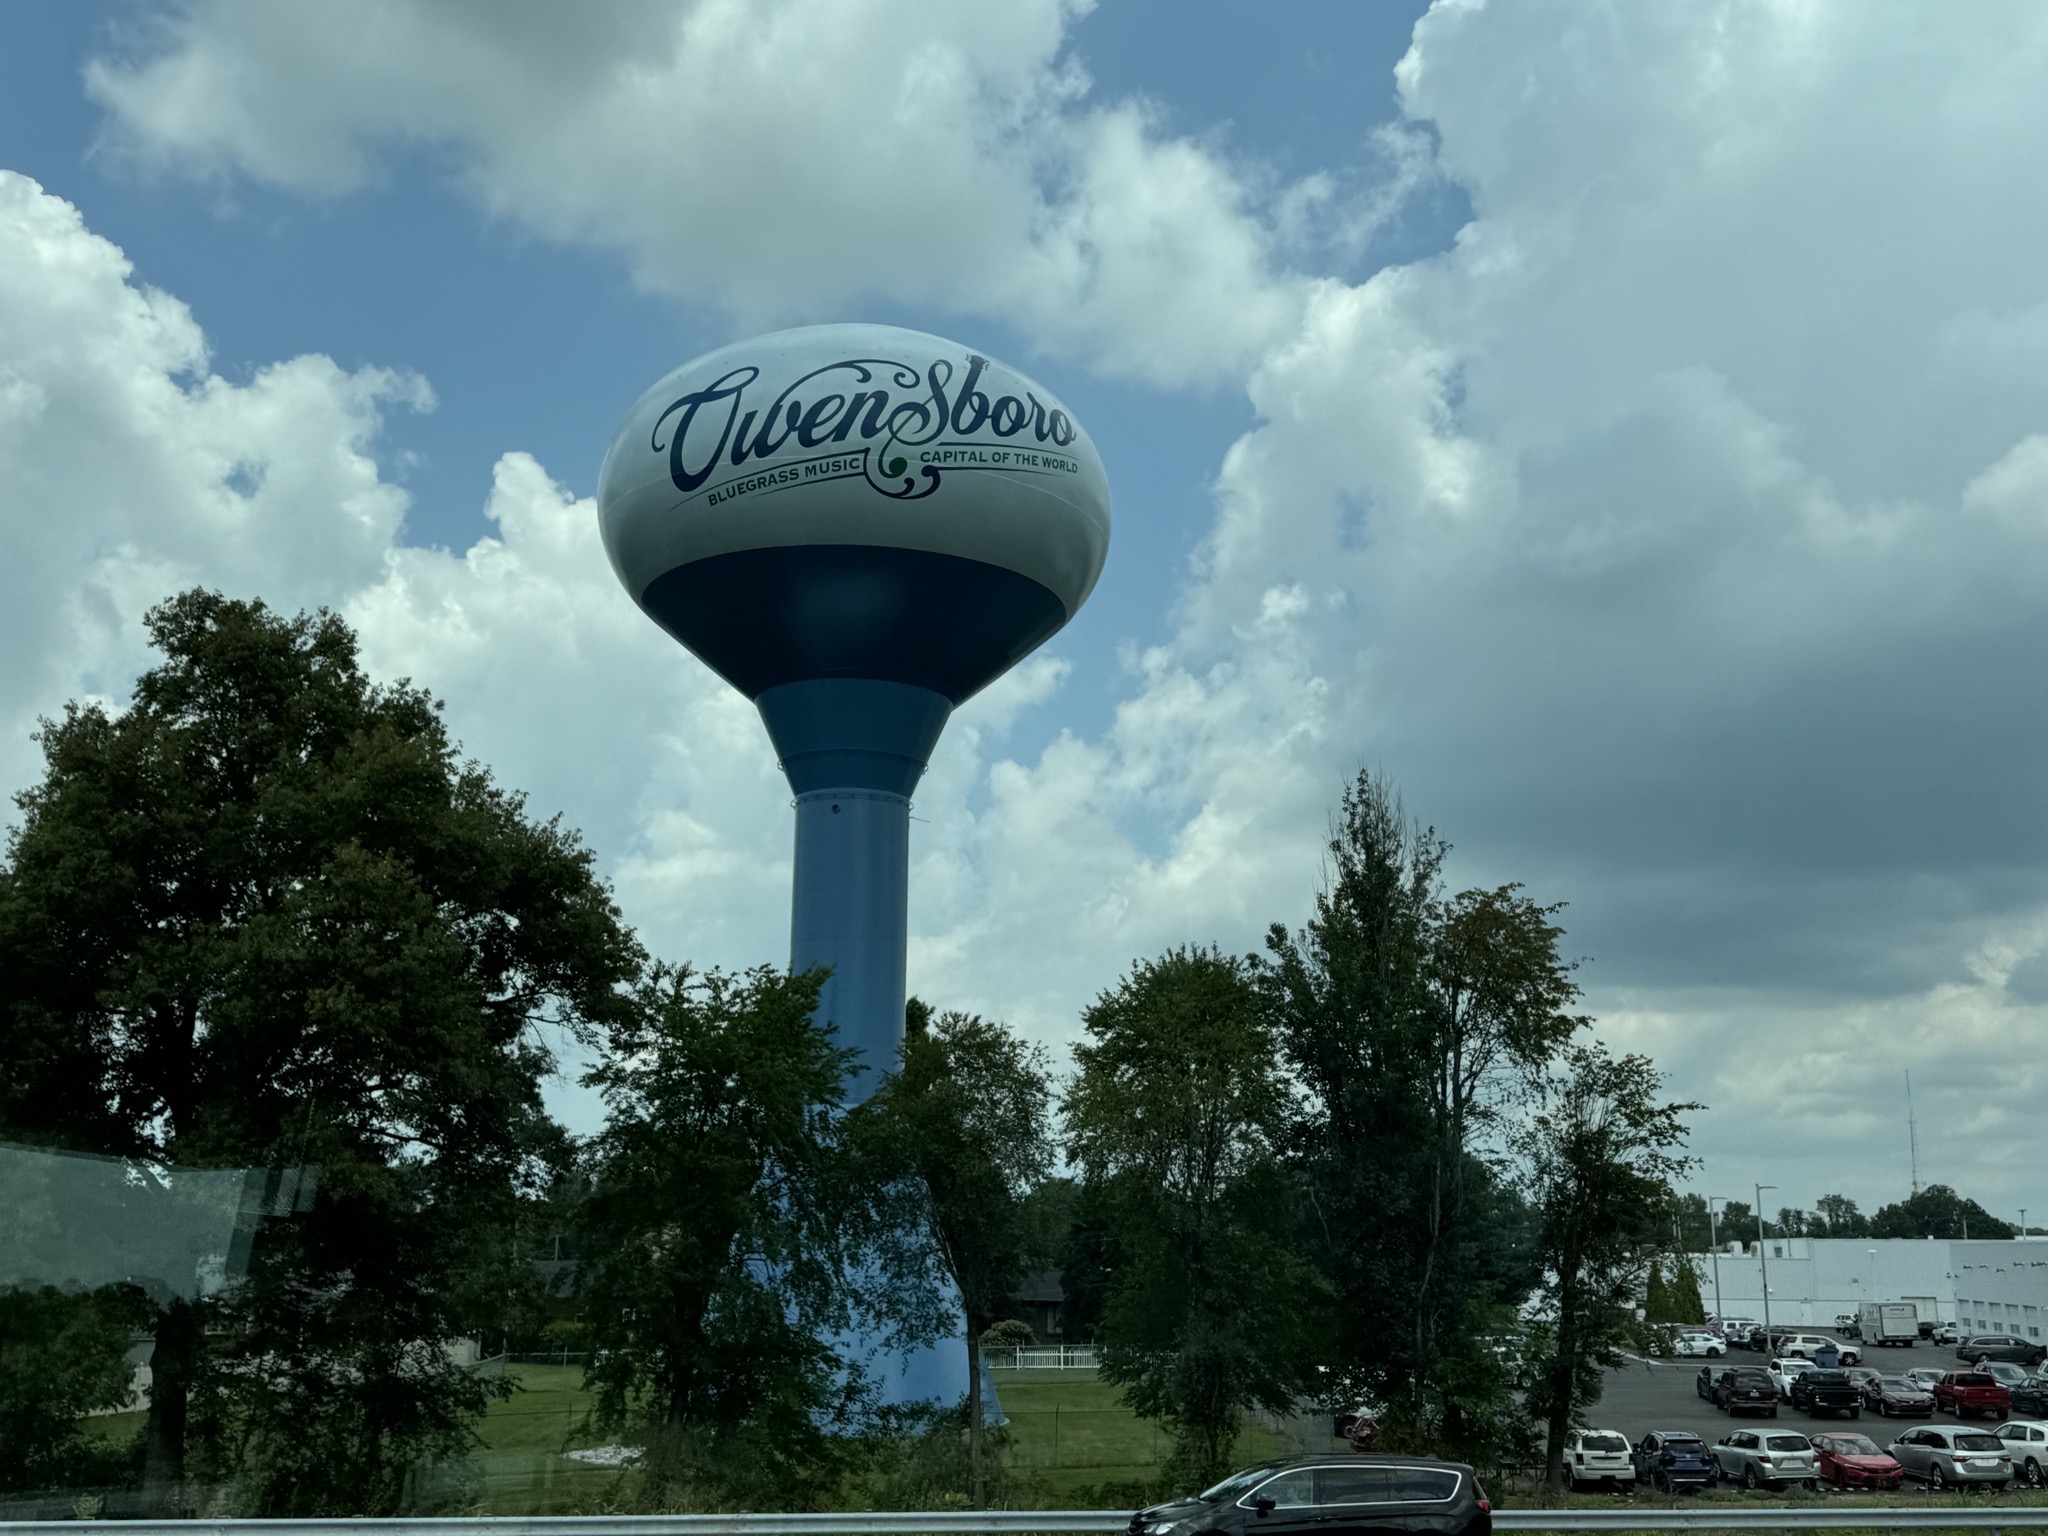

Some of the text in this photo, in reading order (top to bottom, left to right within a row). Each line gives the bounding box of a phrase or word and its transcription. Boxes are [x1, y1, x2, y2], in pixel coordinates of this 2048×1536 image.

[708, 451, 1078, 507] BLUEGRASS MUSIC CAPITAL OF THE WORLD
